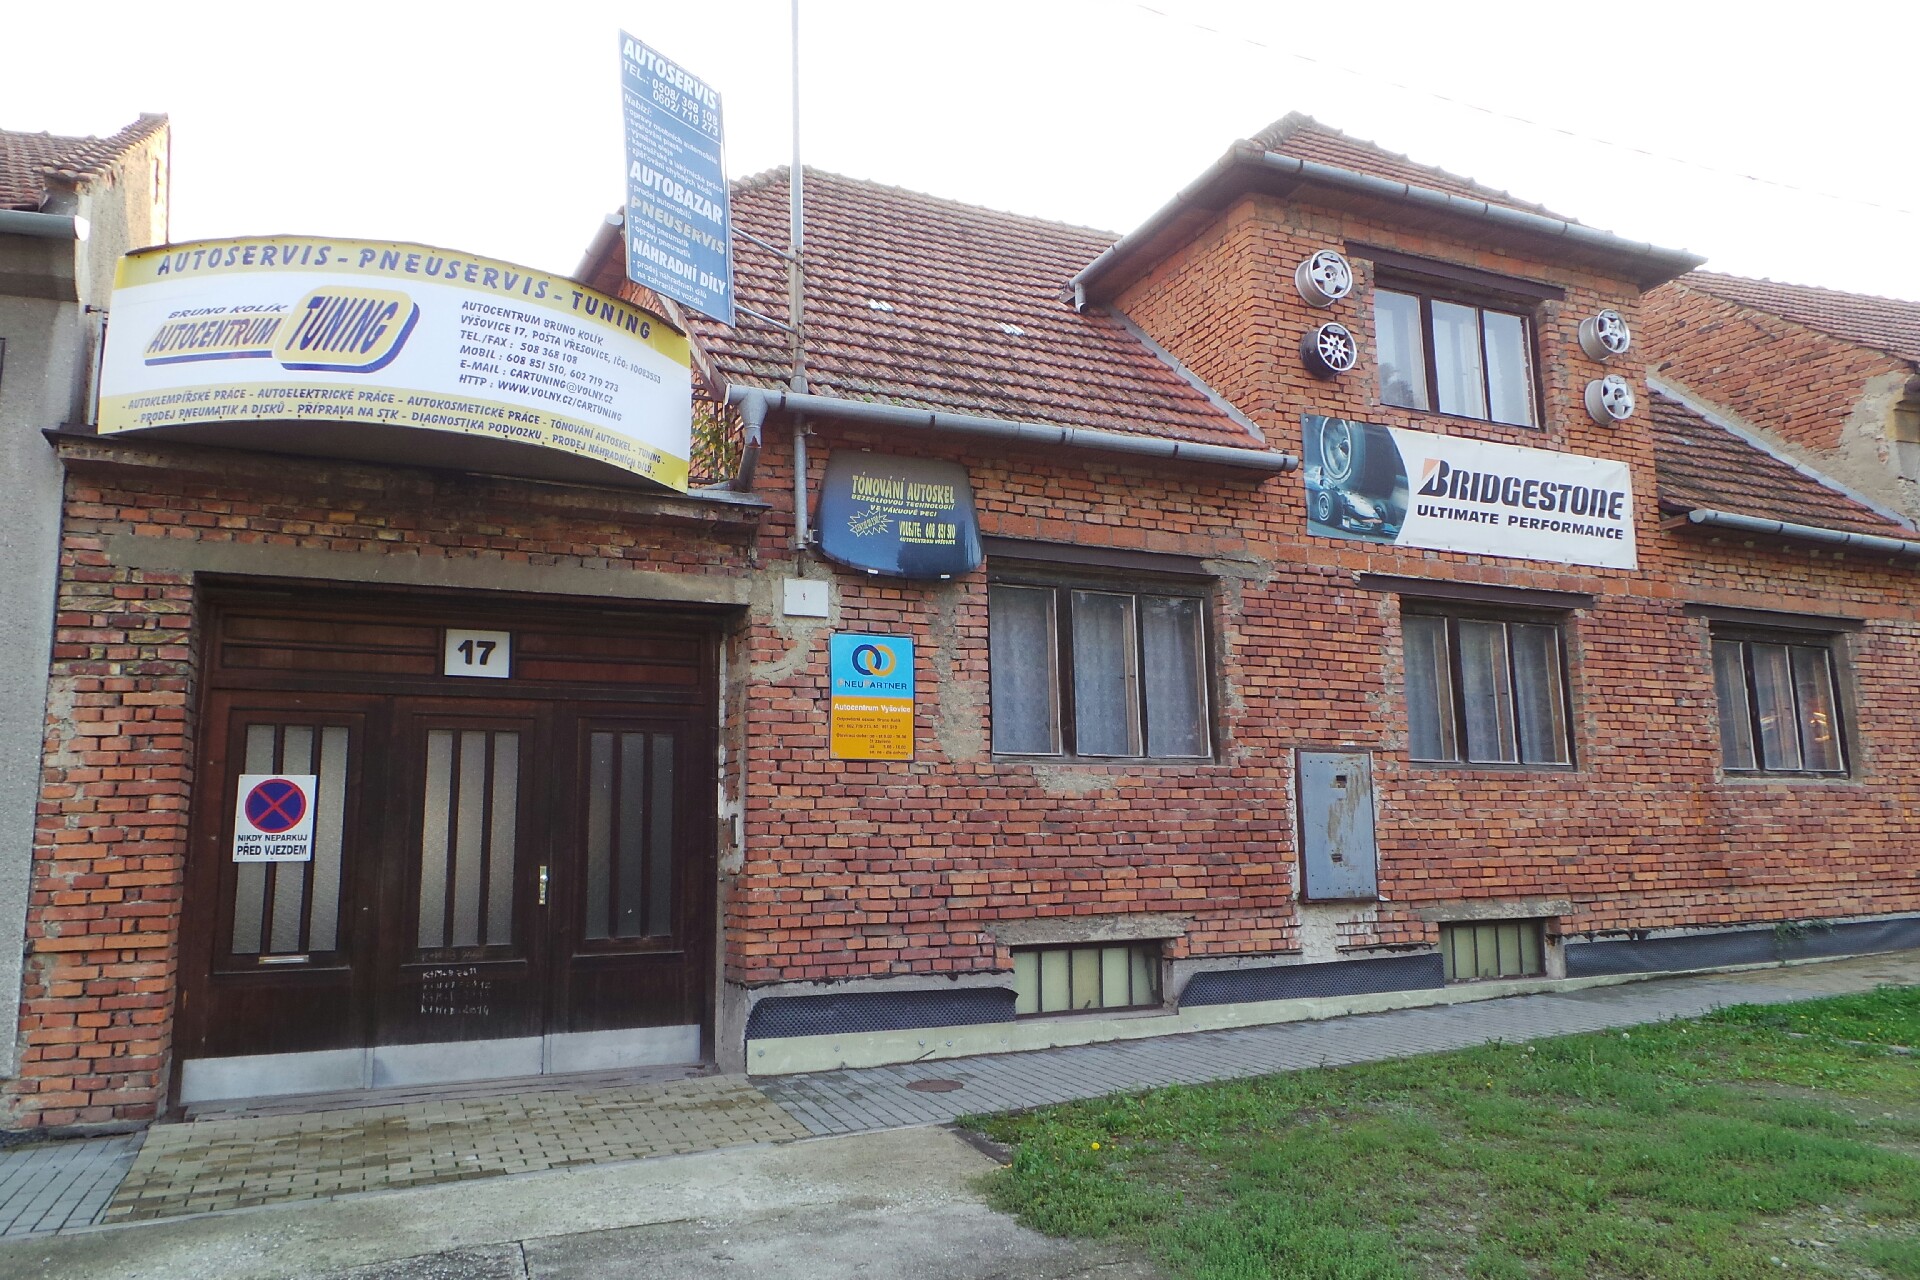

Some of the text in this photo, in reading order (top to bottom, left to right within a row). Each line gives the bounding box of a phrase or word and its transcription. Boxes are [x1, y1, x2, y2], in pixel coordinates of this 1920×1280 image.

[623, 39, 717, 110] AUTOSERVIS
[623, 60, 718, 126] TEL.: 0508/ 368 108
[653, 89, 718, 137] 0602/ 719 273
[630, 160, 723, 226] AUTOBAZAR
[633, 184, 655, 203] prodej
[630, 195, 726, 255] PNEUSERVIS
[634, 216, 690, 248] prodej pneumatik
[634, 226, 658, 243] opravy
[632, 237, 727, 296] NÁHRADNÍ DÍLY
[637, 261, 658, 277] prodej
[157, 245, 650, 340] AUTOSERVIS PNEUSERVIS TUNING
[168, 303, 288, 319] BRUNO KOLÍK
[681, 291, 704, 307] vozidla
[146, 317, 282, 354] AUTOCENTRUM
[285, 296, 399, 354] TUNING
[462, 301, 604, 346] AUTOCENTRUM BRUNO KOLÍK
[514, 326, 528, 338] 17,
[532, 330, 561, 346] POŠTA
[563, 338, 611, 364] VŘESOVICE,
[520, 342, 540, 354] 508
[542, 347, 560, 359] 368
[562, 353, 578, 365] 108
[459, 345, 619, 393] MOBIL 608 851 510, 602 719 273
[460, 359, 613, 404] E-MAIL CARTUNING@VOLNY.CZ
[459, 374, 622, 421] HTTP WWW.VOLNY.CZ/CARTUNING
[128, 389, 211, 410] AUTOKLEMPÍŘSKÉ
[213, 387, 247, 400] PRÁCE
[257, 388, 354, 400] AUTOELEKTRICKÉ
[357, 390, 395, 403] PRÁCE
[407, 396, 504, 418] AUTOKOSMETICKÉ
[507, 410, 541, 425] PRÁCE
[595, 431, 631, 452] AUTOSKEL
[638, 447, 661, 464] TUNING
[140, 410, 176, 423] PRODEJ
[178, 405, 239, 419] PNEUMATIK
[240, 404, 248, 414] A
[251, 401, 285, 414] DISKŮ
[297, 402, 354, 416] PŘÍPRAVA
[357, 407, 374, 417] NA
[376, 408, 399, 420] STK
[411, 411, 485, 430] DIAGNOSTIKA
[487, 422, 542, 440] PODVOZKU
[552, 434, 586, 451] PRODEJ
[588, 444, 635, 468] NÁHRADNÍCH
[852, 471, 955, 503] TÓNOVÁNÍ AUTOSKEL
[1417, 458, 1625, 520] BRIDGESTONE
[1417, 504, 1624, 540] ULTIMATE PERFORMANCE
[458, 639, 496, 666] 17
[834, 703, 911, 713] Autocentrum Vyšovice
[236, 842, 307, 856] PŘED VJEZDEM
[237, 834, 308, 842] NIKDY NEPARKUJ
